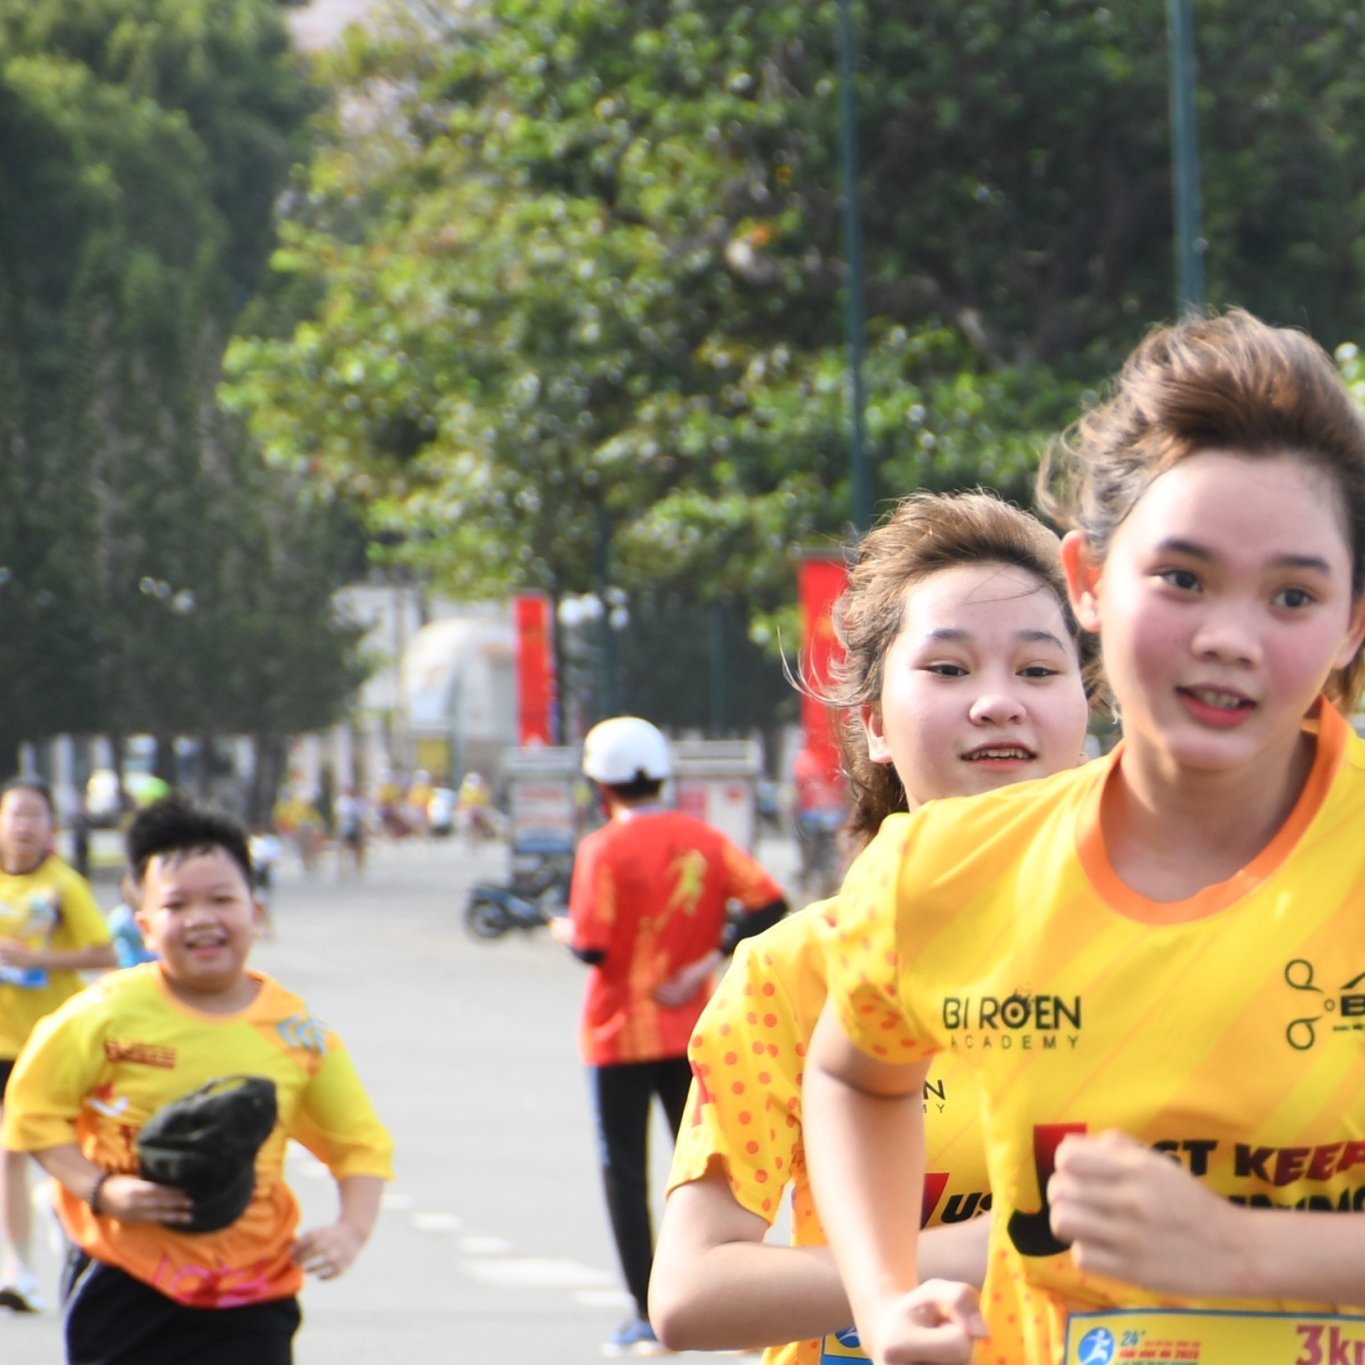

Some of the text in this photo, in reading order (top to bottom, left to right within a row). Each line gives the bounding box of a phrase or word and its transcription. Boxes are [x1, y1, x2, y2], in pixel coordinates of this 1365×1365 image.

[943, 993, 1081, 1031] BI ROEN
[949, 1034, 1079, 1050] ACADEMY
